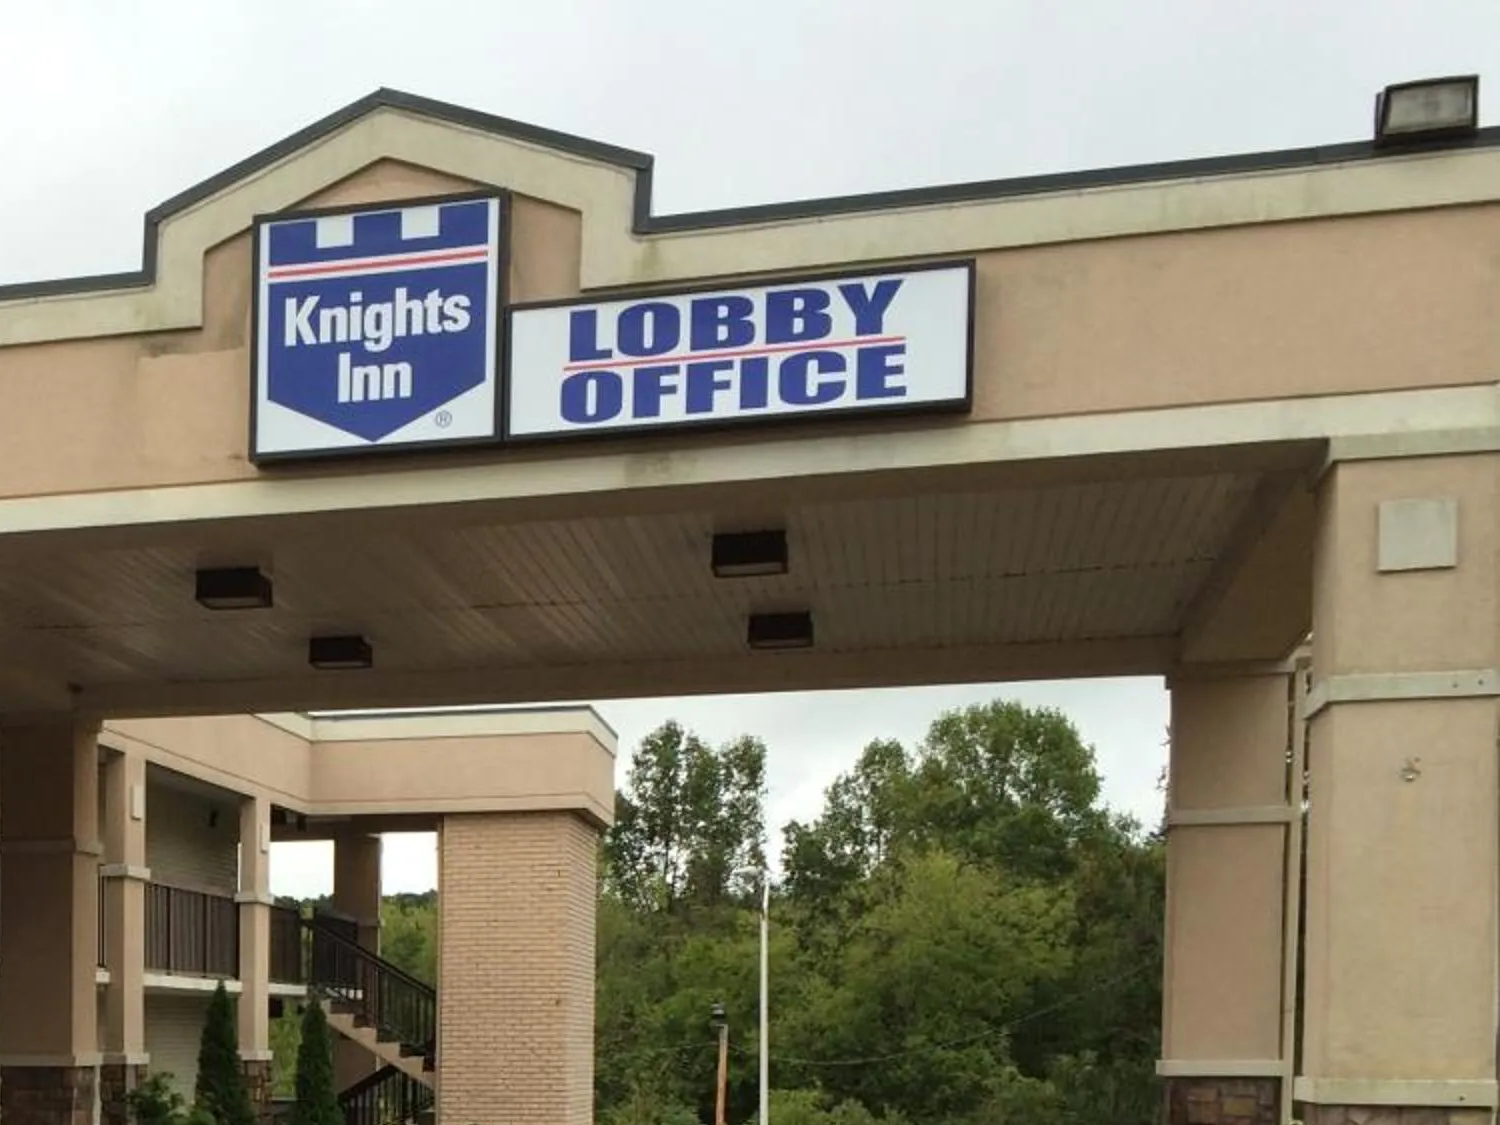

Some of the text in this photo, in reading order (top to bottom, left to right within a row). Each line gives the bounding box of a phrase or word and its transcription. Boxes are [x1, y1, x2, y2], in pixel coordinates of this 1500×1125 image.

[284, 287, 471, 352] Knights
[569, 279, 904, 362] LOBBY
[338, 352, 412, 404] Inn
[560, 344, 907, 424] OFFICE
